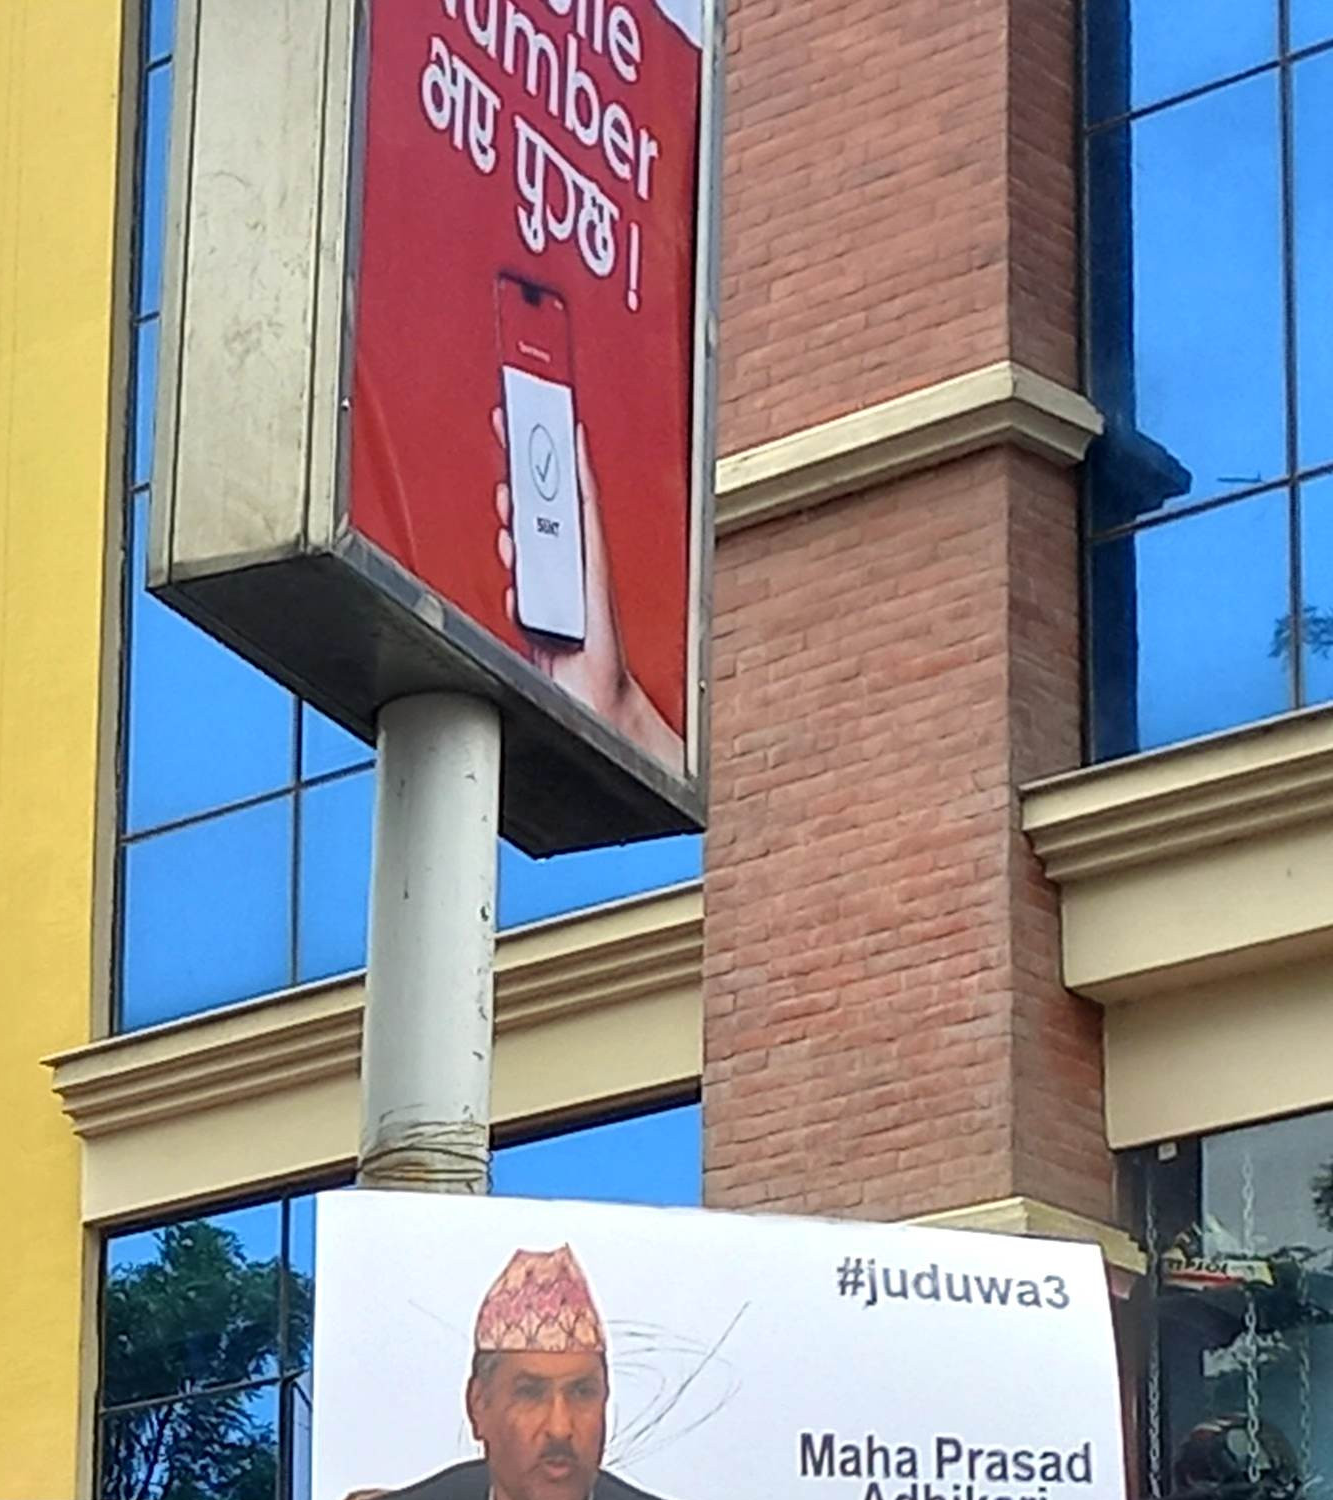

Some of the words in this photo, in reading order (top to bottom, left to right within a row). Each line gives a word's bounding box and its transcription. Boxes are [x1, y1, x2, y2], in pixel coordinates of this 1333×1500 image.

[444, 0, 659, 200] umber
[837, 1257, 1069, 1309] #juduwa3
[801, 1433, 918, 1479] Maha
[936, 1437, 1092, 1484] Prasad
